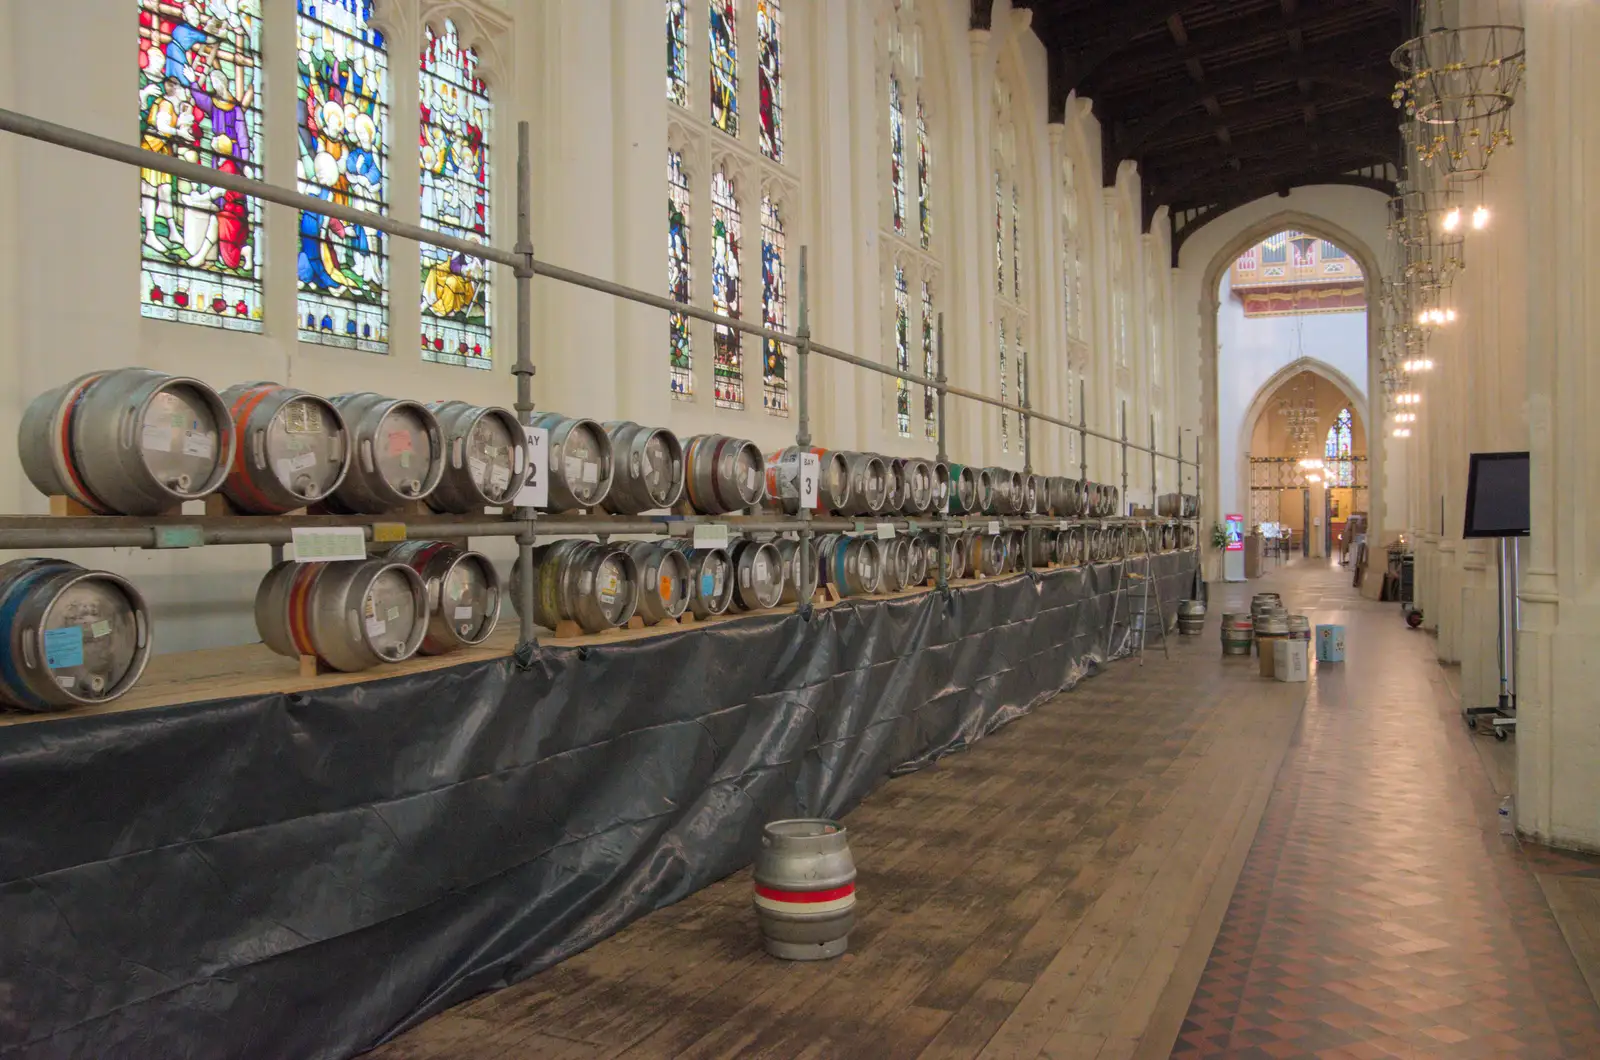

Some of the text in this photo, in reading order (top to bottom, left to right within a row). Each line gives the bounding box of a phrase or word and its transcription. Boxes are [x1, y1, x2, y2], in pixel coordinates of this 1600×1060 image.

[527, 435, 540, 446] AY
[804, 458, 814, 466] BAY
[524, 462, 537, 487] 2
[805, 477, 812, 495] 3
